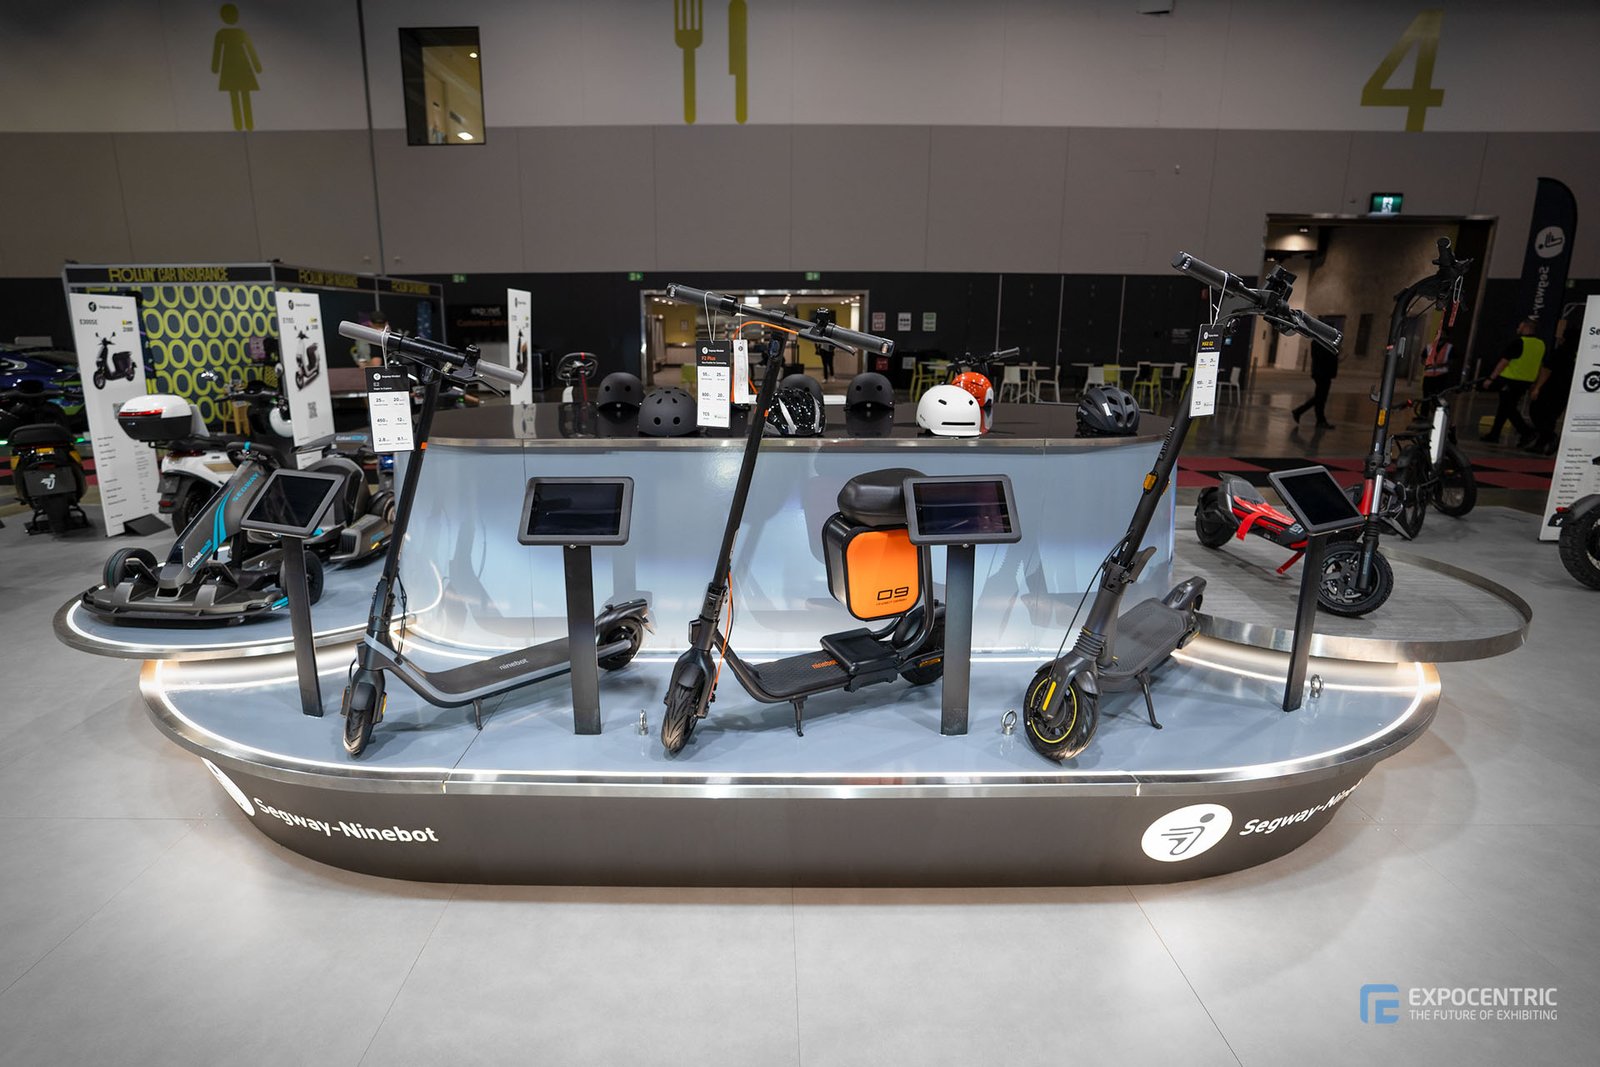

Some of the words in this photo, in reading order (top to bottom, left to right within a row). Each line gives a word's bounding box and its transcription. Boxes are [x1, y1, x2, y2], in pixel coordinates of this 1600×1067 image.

[1360, 8, 1446, 132] 4
[157, 268, 176, 282] CAR
[178, 267, 229, 282] INSURANCE
[499, 658, 529, 671] ninebot
[253, 797, 439, 842] Segway-Ninebot
